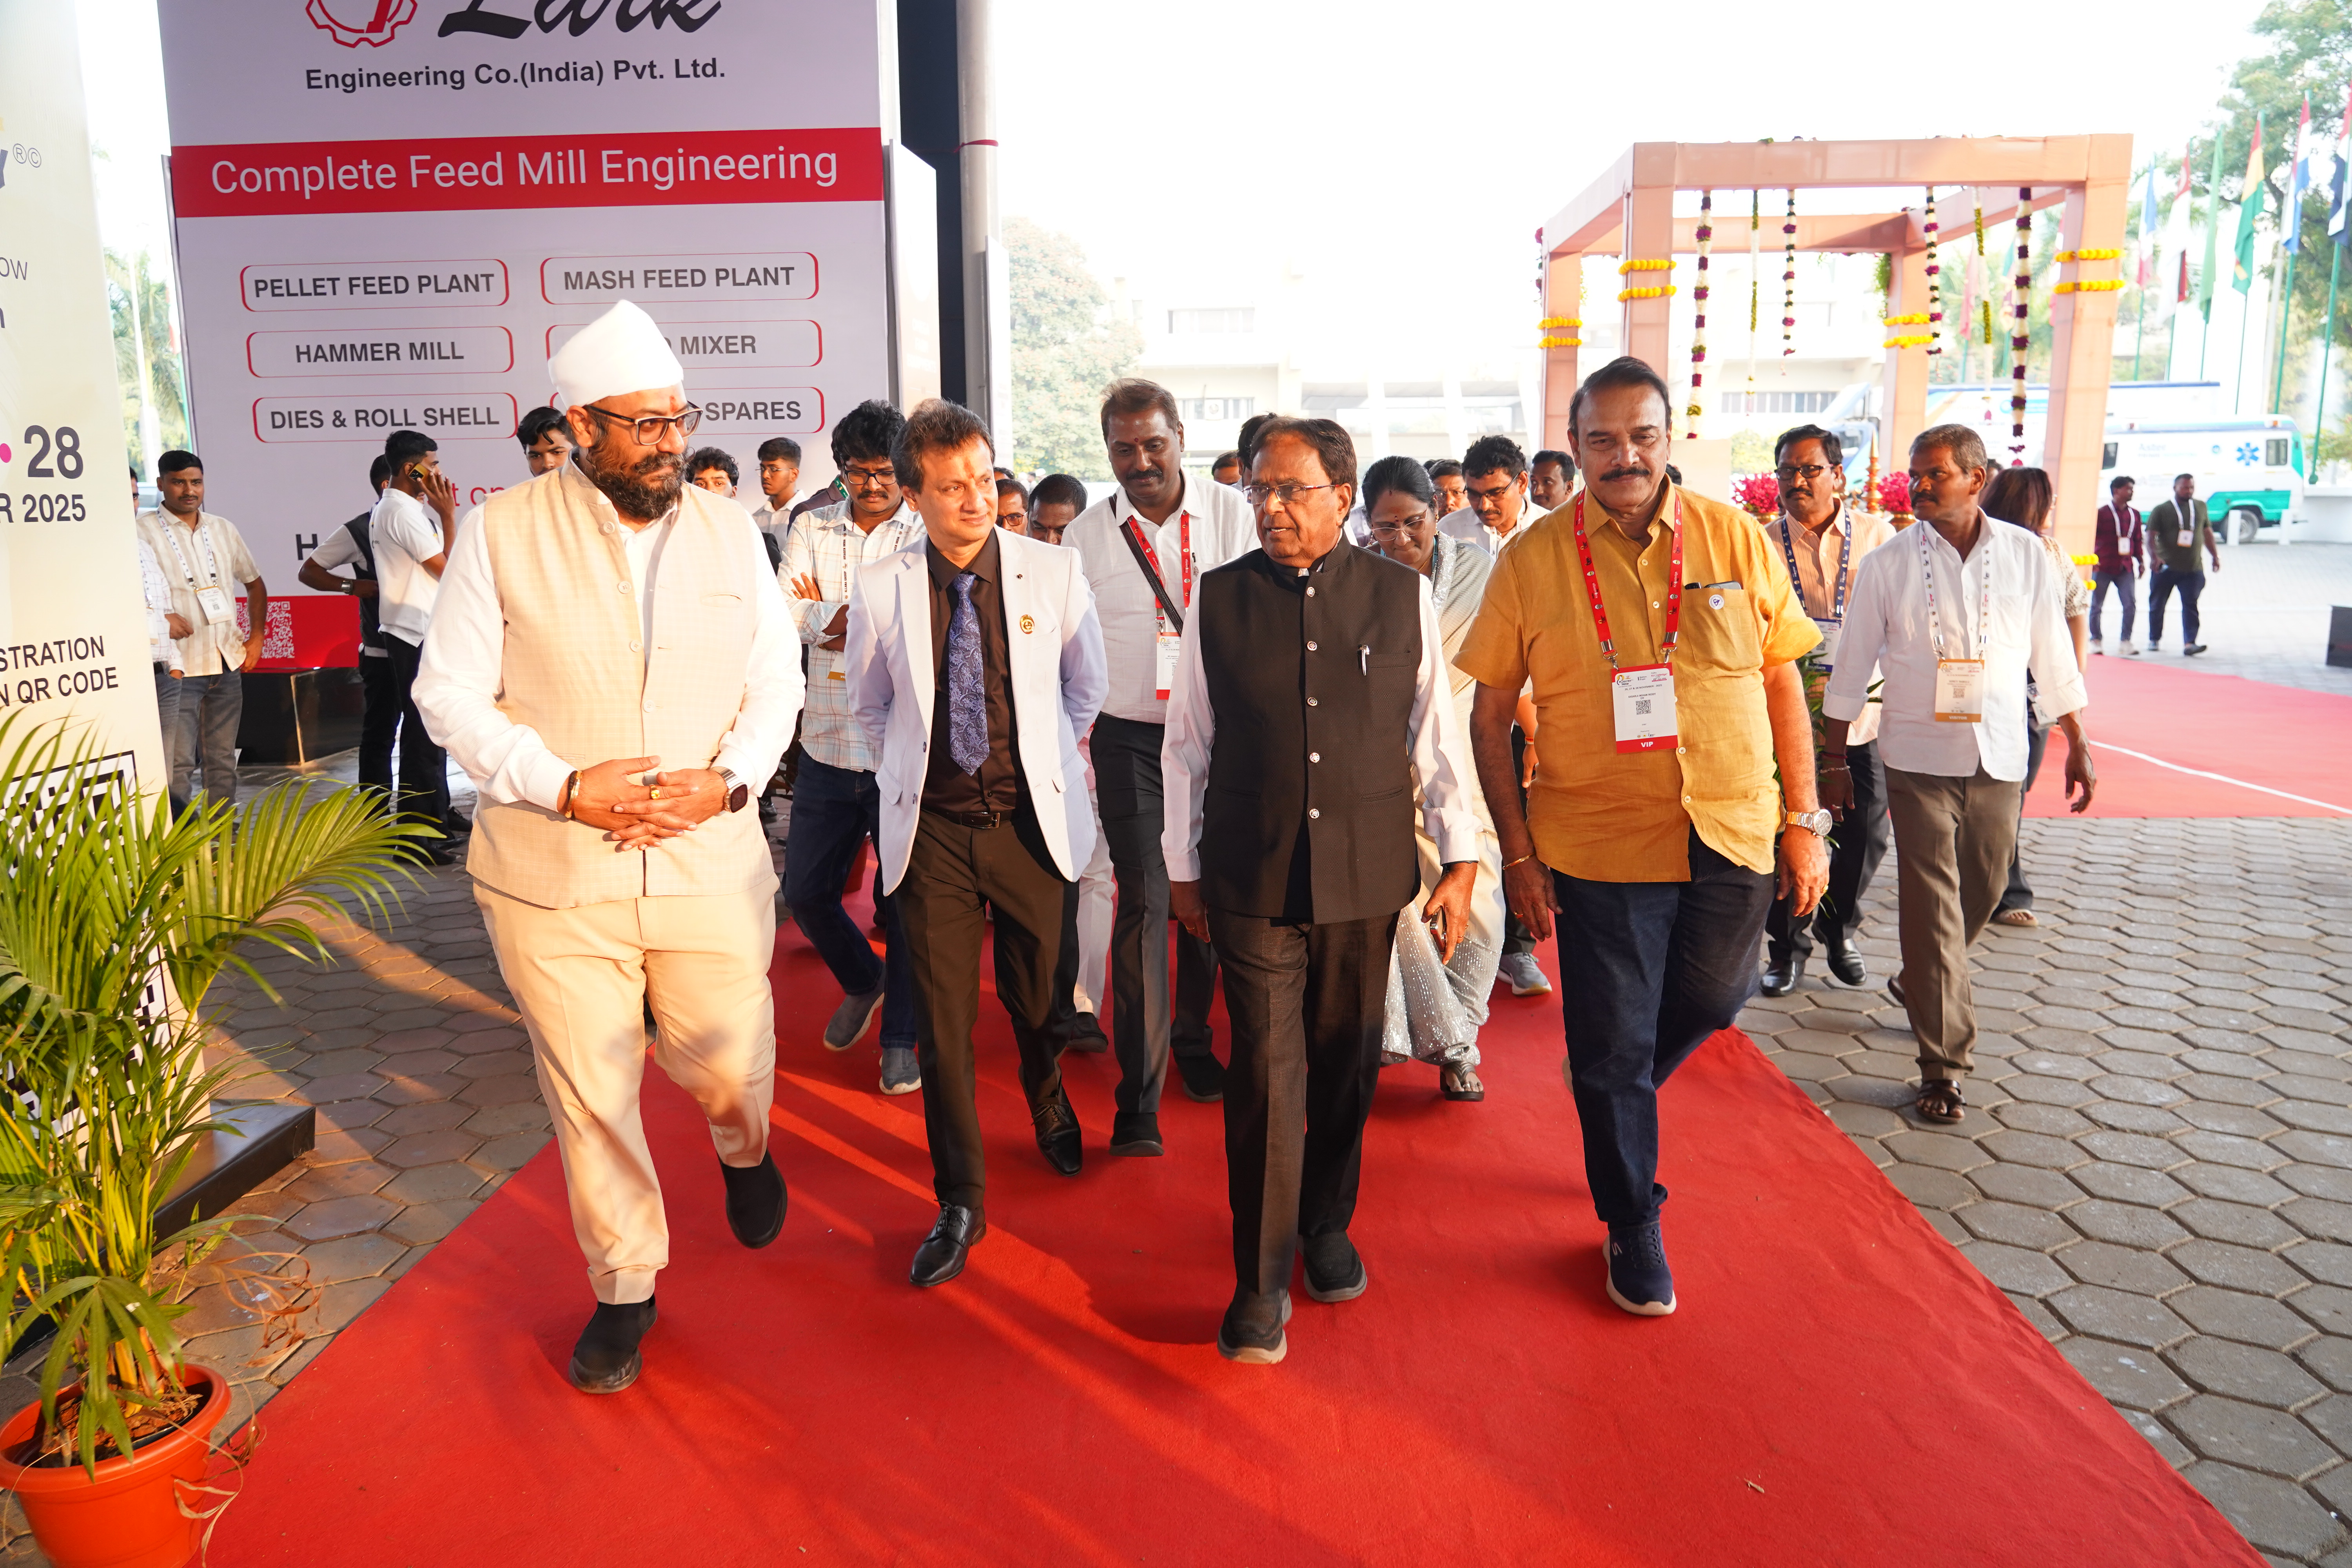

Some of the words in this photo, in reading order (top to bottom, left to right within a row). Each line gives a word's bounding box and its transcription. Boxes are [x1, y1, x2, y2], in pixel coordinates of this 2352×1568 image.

[306, 65, 465, 93] Engineering
[475, 60, 603, 88] Co.(India)
[614, 60, 664, 80] Pvt.
[675, 58, 724, 78] Ltd.
[212, 156, 396, 200] Complete
[410, 151, 503, 188] Feed
[518, 149, 586, 185] Mill
[601, 145, 837, 191] Engineering
[254, 277, 340, 298] PELLET
[348, 276, 409, 295] FEED
[417, 274, 494, 294] PLANT
[564, 270, 634, 290] MASH
[643, 269, 706, 288] FEED
[715, 267, 795, 287] PLANT
[296, 343, 401, 363] HAMMER
[409, 341, 464, 360] MILL
[681, 335, 757, 355] MIXER
[270, 410, 324, 429] DIES
[332, 410, 347, 428] &
[355, 408, 417, 427] ROLL
[423, 407, 499, 426] SHELL
[705, 401, 801, 421] SPARES
[24, 425, 83, 479] 28
[22, 494, 86, 523] 2025
[17, 678, 51, 704] QR
[58, 667, 118, 697] CODE
